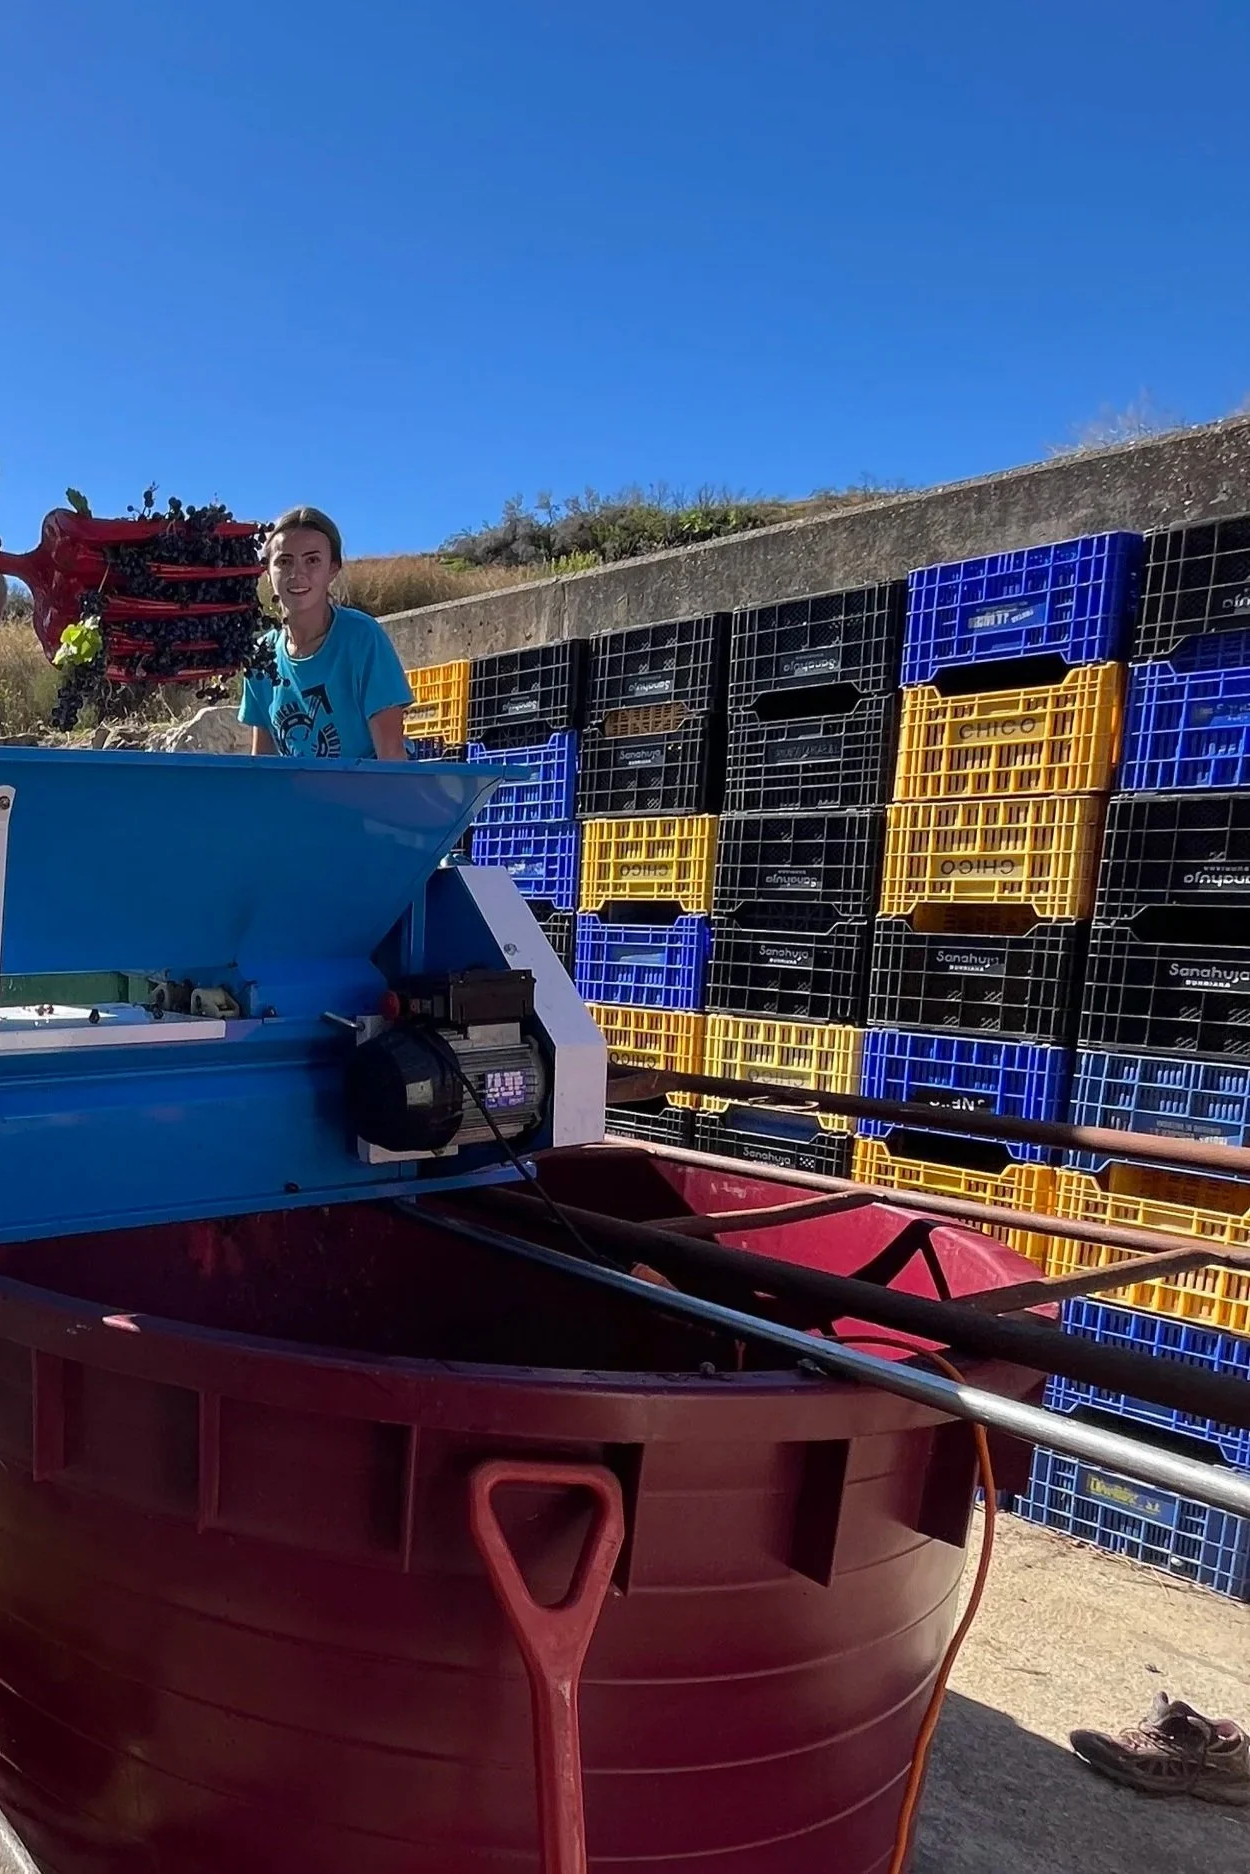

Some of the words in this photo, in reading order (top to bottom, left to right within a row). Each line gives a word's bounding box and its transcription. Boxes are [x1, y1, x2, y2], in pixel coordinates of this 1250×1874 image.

[958, 715, 1037, 741] CHICO
[620, 862, 670, 878] CHICO
[940, 857, 1016, 876] CHICO
[758, 944, 810, 963] Sanahuja
[936, 950, 1000, 969] Sanahuja
[1168, 962, 1250, 984] Sanahuja
